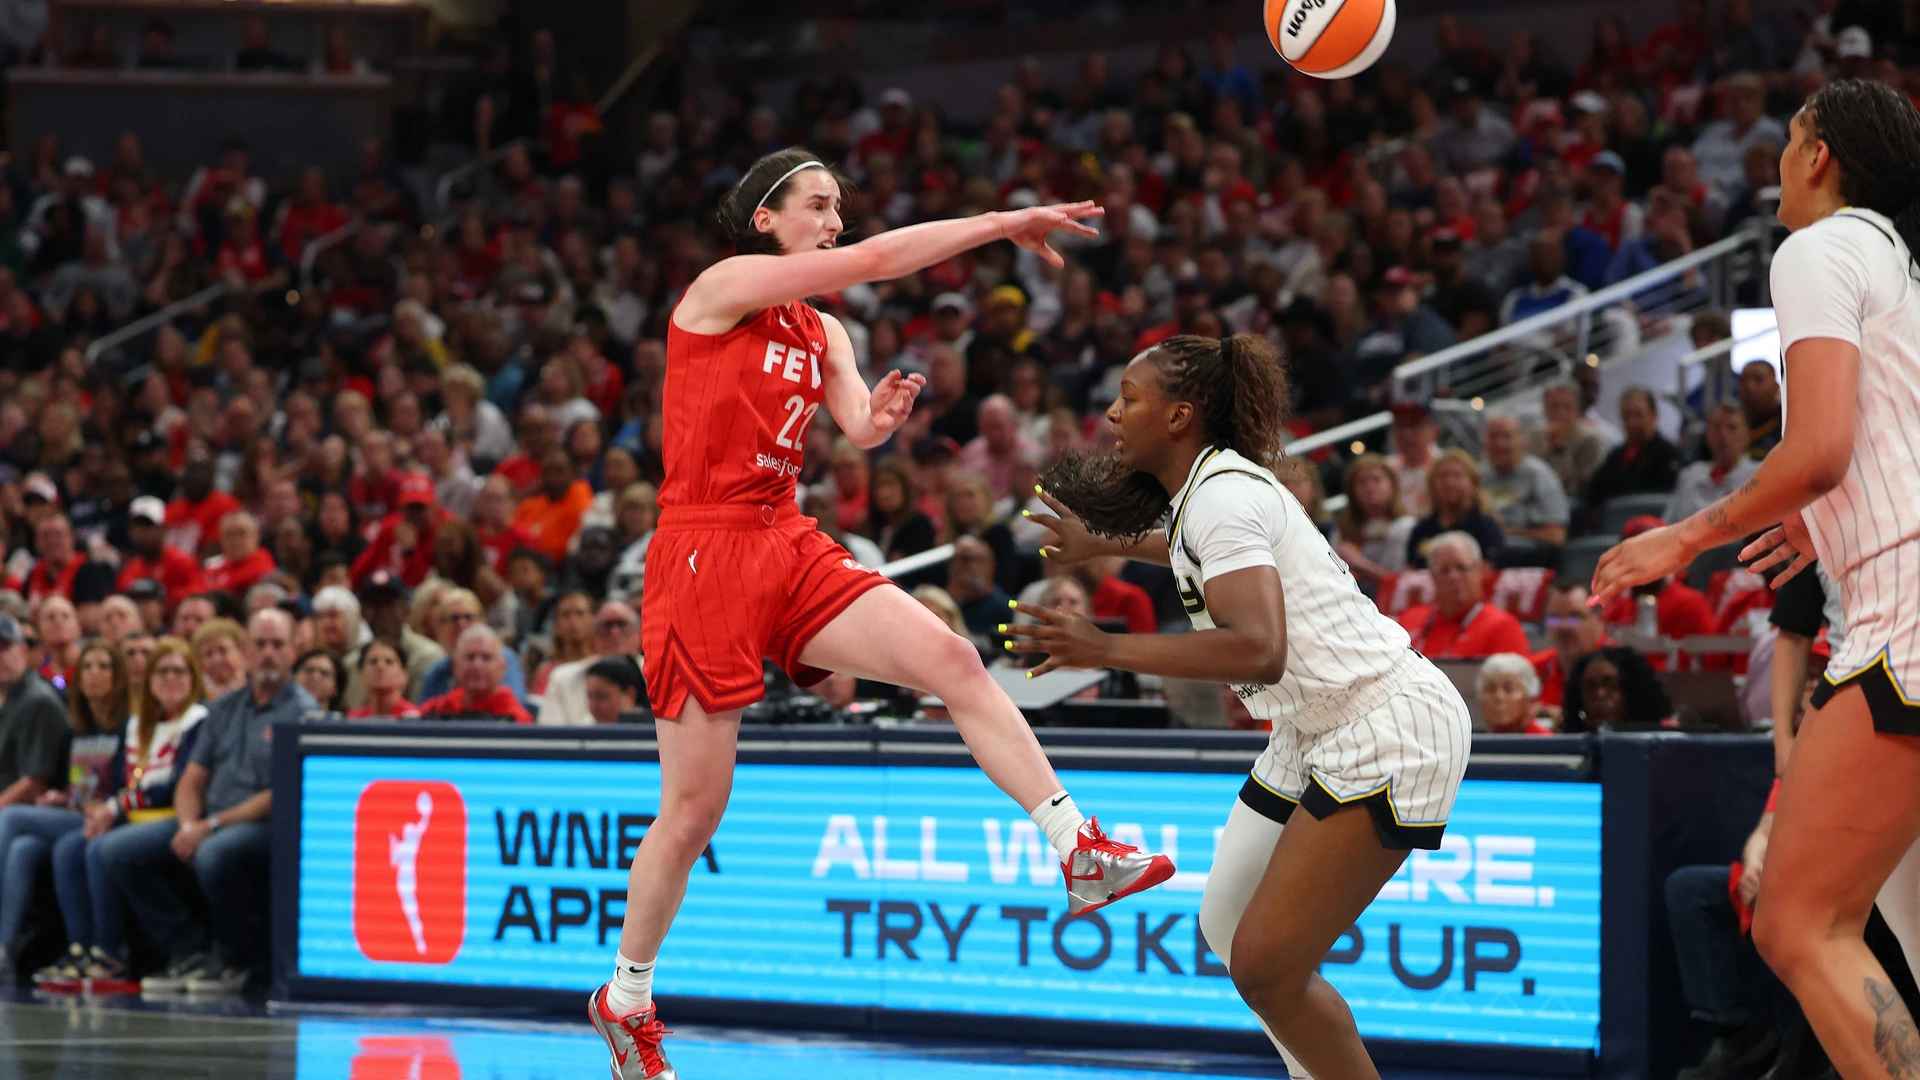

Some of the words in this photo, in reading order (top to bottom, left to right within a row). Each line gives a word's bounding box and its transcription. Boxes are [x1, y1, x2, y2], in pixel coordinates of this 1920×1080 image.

[776, 395, 820, 452] 22
[811, 813, 969, 884] ALL
[825, 899, 981, 962] TRY
[1000, 905, 1113, 971] TO
[1388, 922, 1536, 997] UP.
